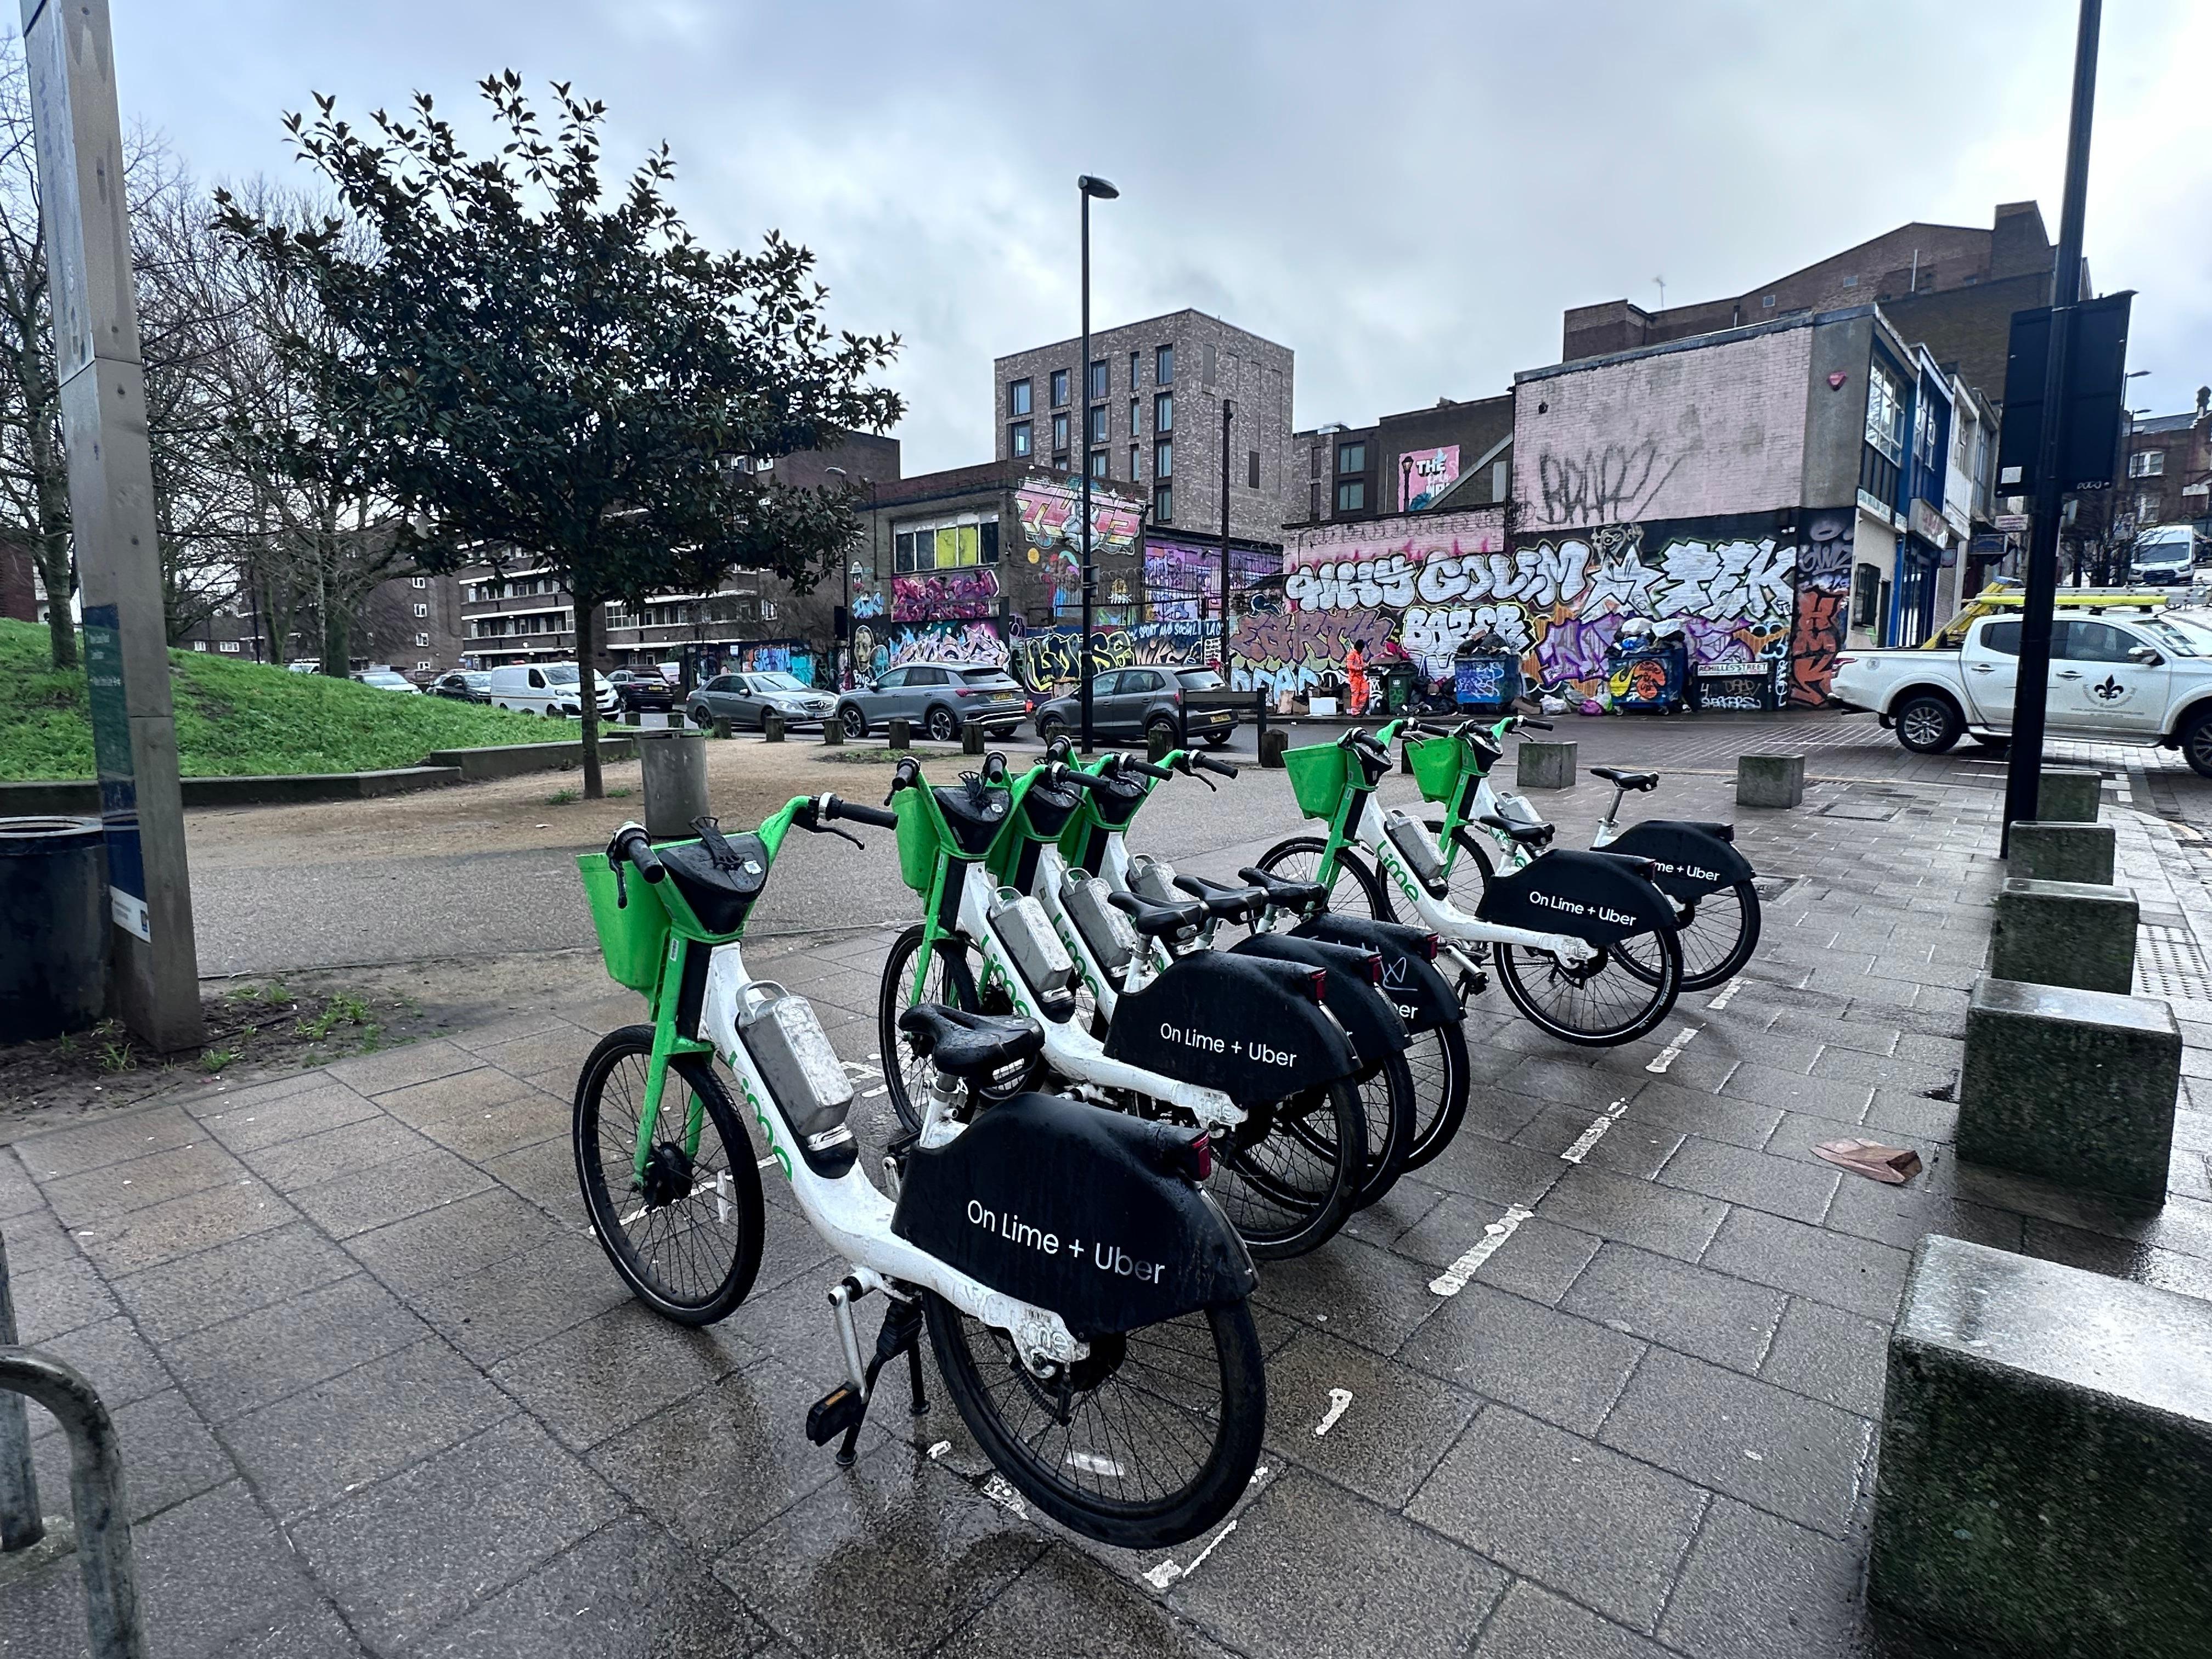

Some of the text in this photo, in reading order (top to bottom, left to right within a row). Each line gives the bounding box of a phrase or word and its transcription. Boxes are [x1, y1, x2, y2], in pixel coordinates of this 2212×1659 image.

[1417, 459, 1446, 475] THE
[1377, 840, 1419, 901] Lime
[1654, 862, 1674, 873] me
[1687, 865, 1720, 881] Uber
[1530, 891, 1637, 926] On Lime + Uber
[1160, 1023, 1297, 1067] On Lime + Uber
[968, 1199, 1165, 1283] On Lime + Uber
